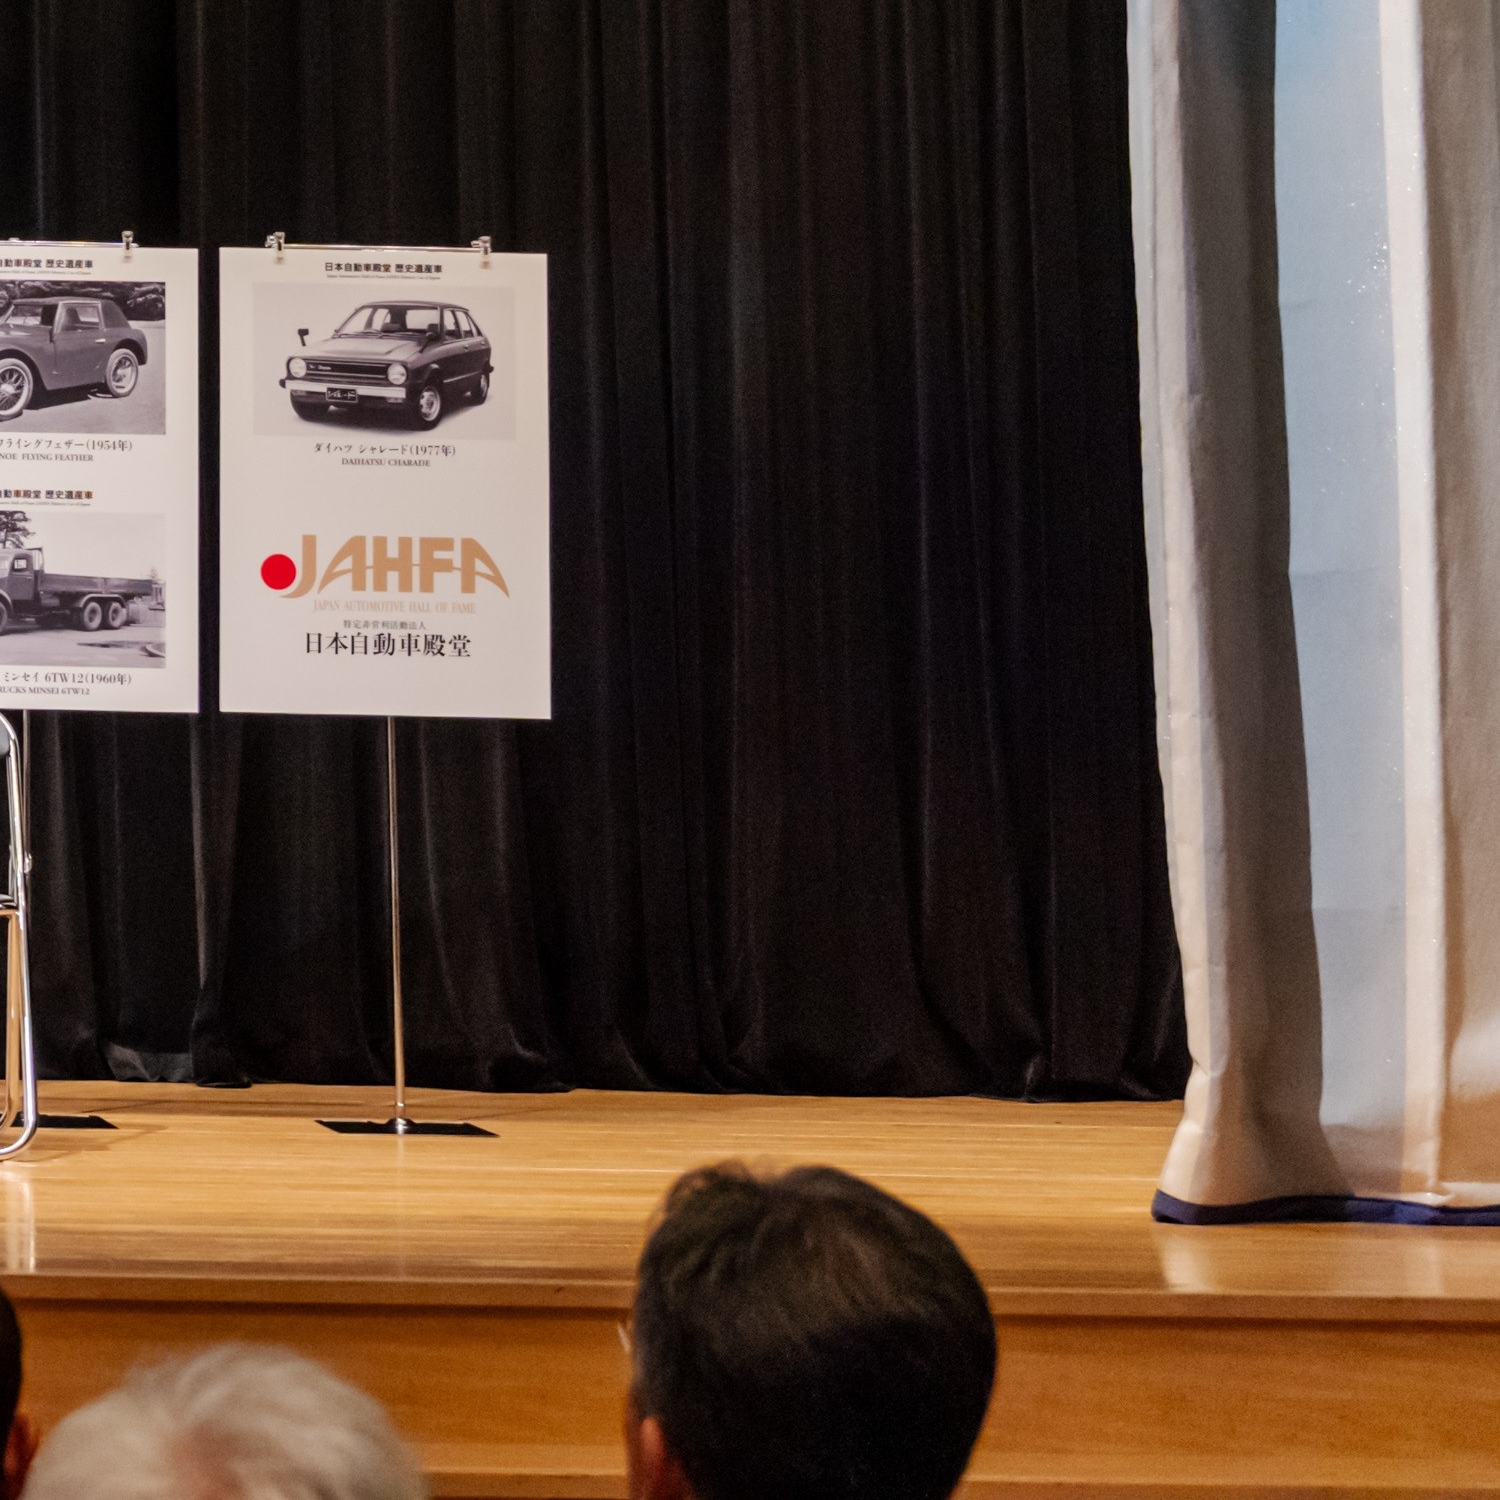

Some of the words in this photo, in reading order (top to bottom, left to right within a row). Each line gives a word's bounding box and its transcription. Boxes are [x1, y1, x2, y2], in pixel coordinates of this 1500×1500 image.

[325, 262, 391, 272] 日本自動車殿堂
[314, 443, 353, 454] ダイハツ
[341, 458, 386, 466] DAIHATSU
[388, 459, 430, 467] CHARADE
[279, 534, 510, 599] JAHFA
[305, 631, 471, 657] 日本自動車殿堂
